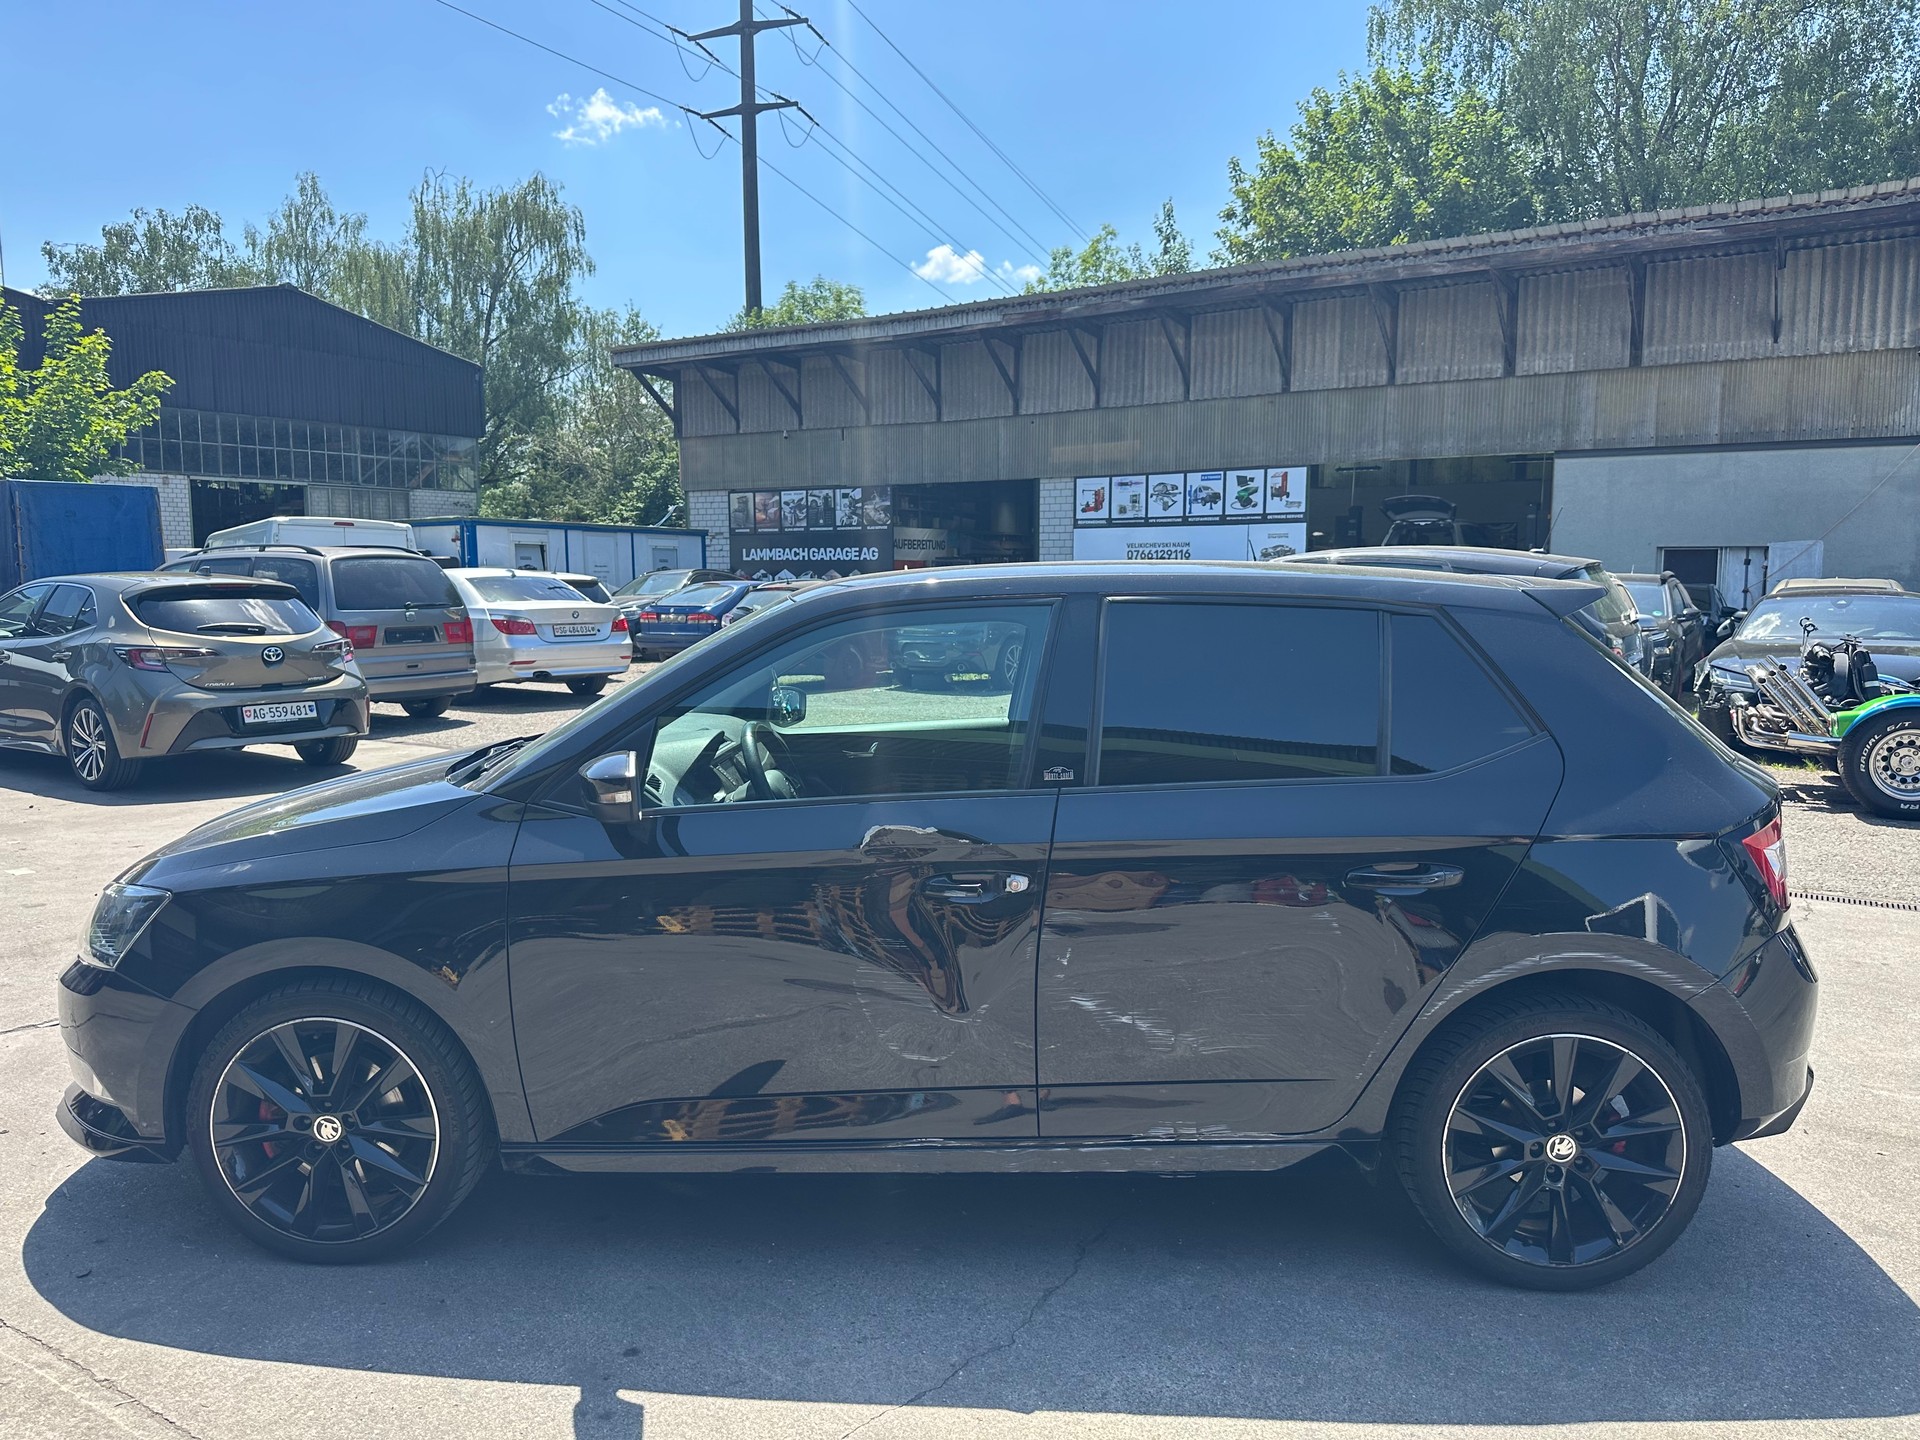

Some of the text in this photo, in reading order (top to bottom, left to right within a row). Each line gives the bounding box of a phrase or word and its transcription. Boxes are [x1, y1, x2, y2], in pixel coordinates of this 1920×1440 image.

[893, 539, 946, 551] AUFBEREITUNG
[742, 547, 879, 561] LAMMBACH GARAGE AG
[1126, 549, 1191, 560] 0766129116
[1860, 721, 1912, 772] RADIAL G/T
